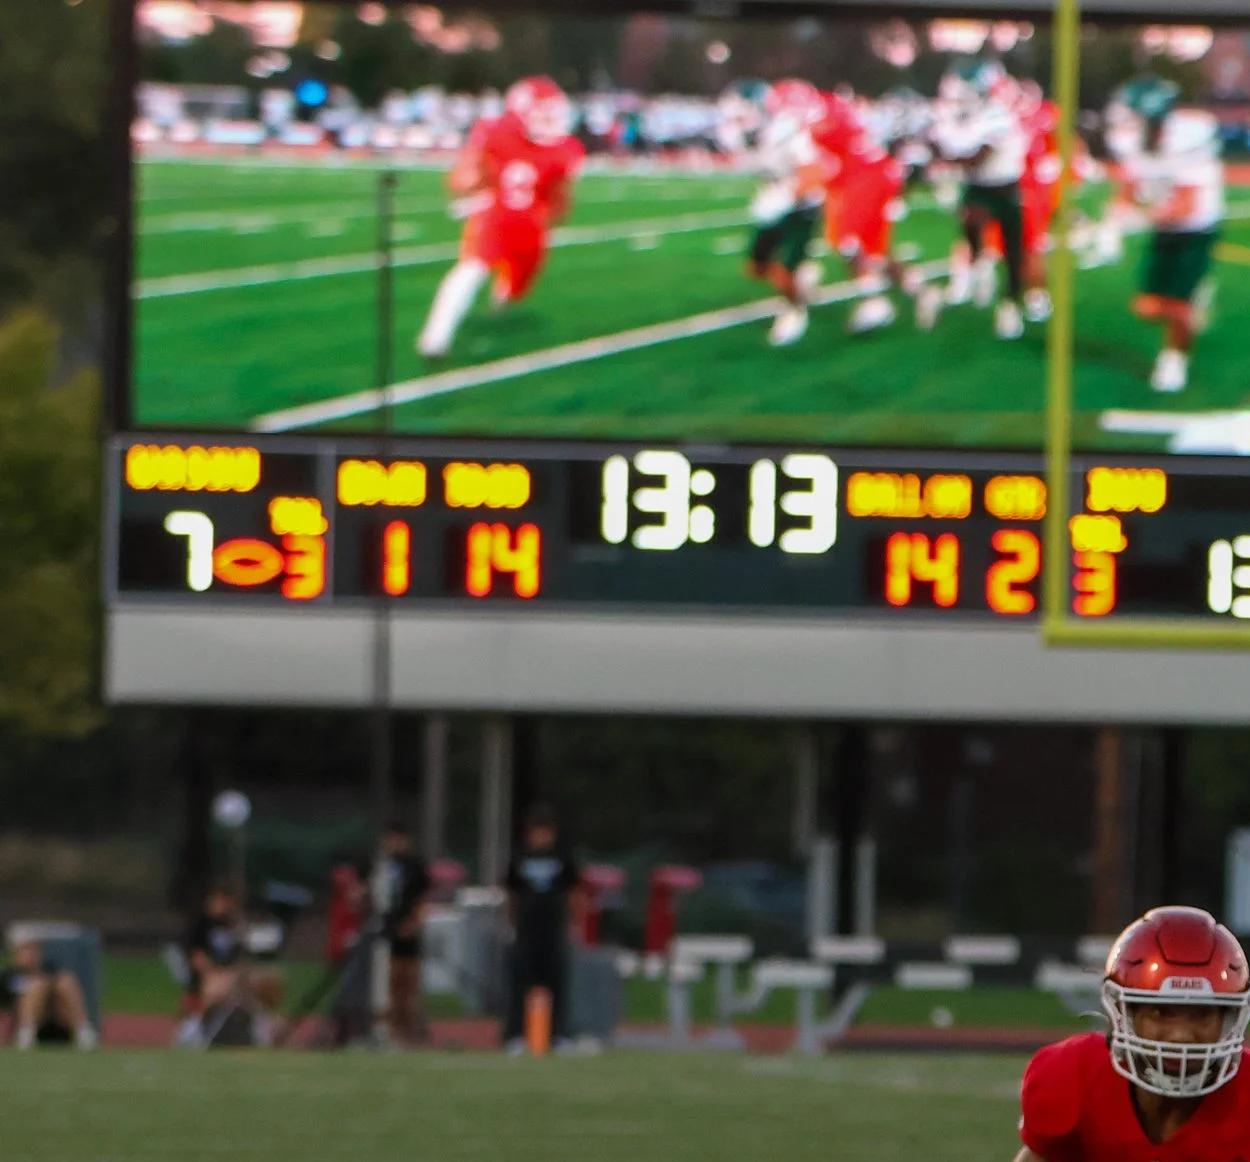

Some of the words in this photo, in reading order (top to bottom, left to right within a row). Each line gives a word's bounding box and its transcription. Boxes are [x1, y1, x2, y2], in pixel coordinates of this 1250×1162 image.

[602, 450, 838, 555] 13:13
[164, 510, 214, 592] 7
[383, 520, 410, 596] 1
[466, 522, 540, 598] 14
[886, 532, 959, 607] 14
[986, 529, 1039, 614] 2
[1073, 549, 1116, 616] 3
